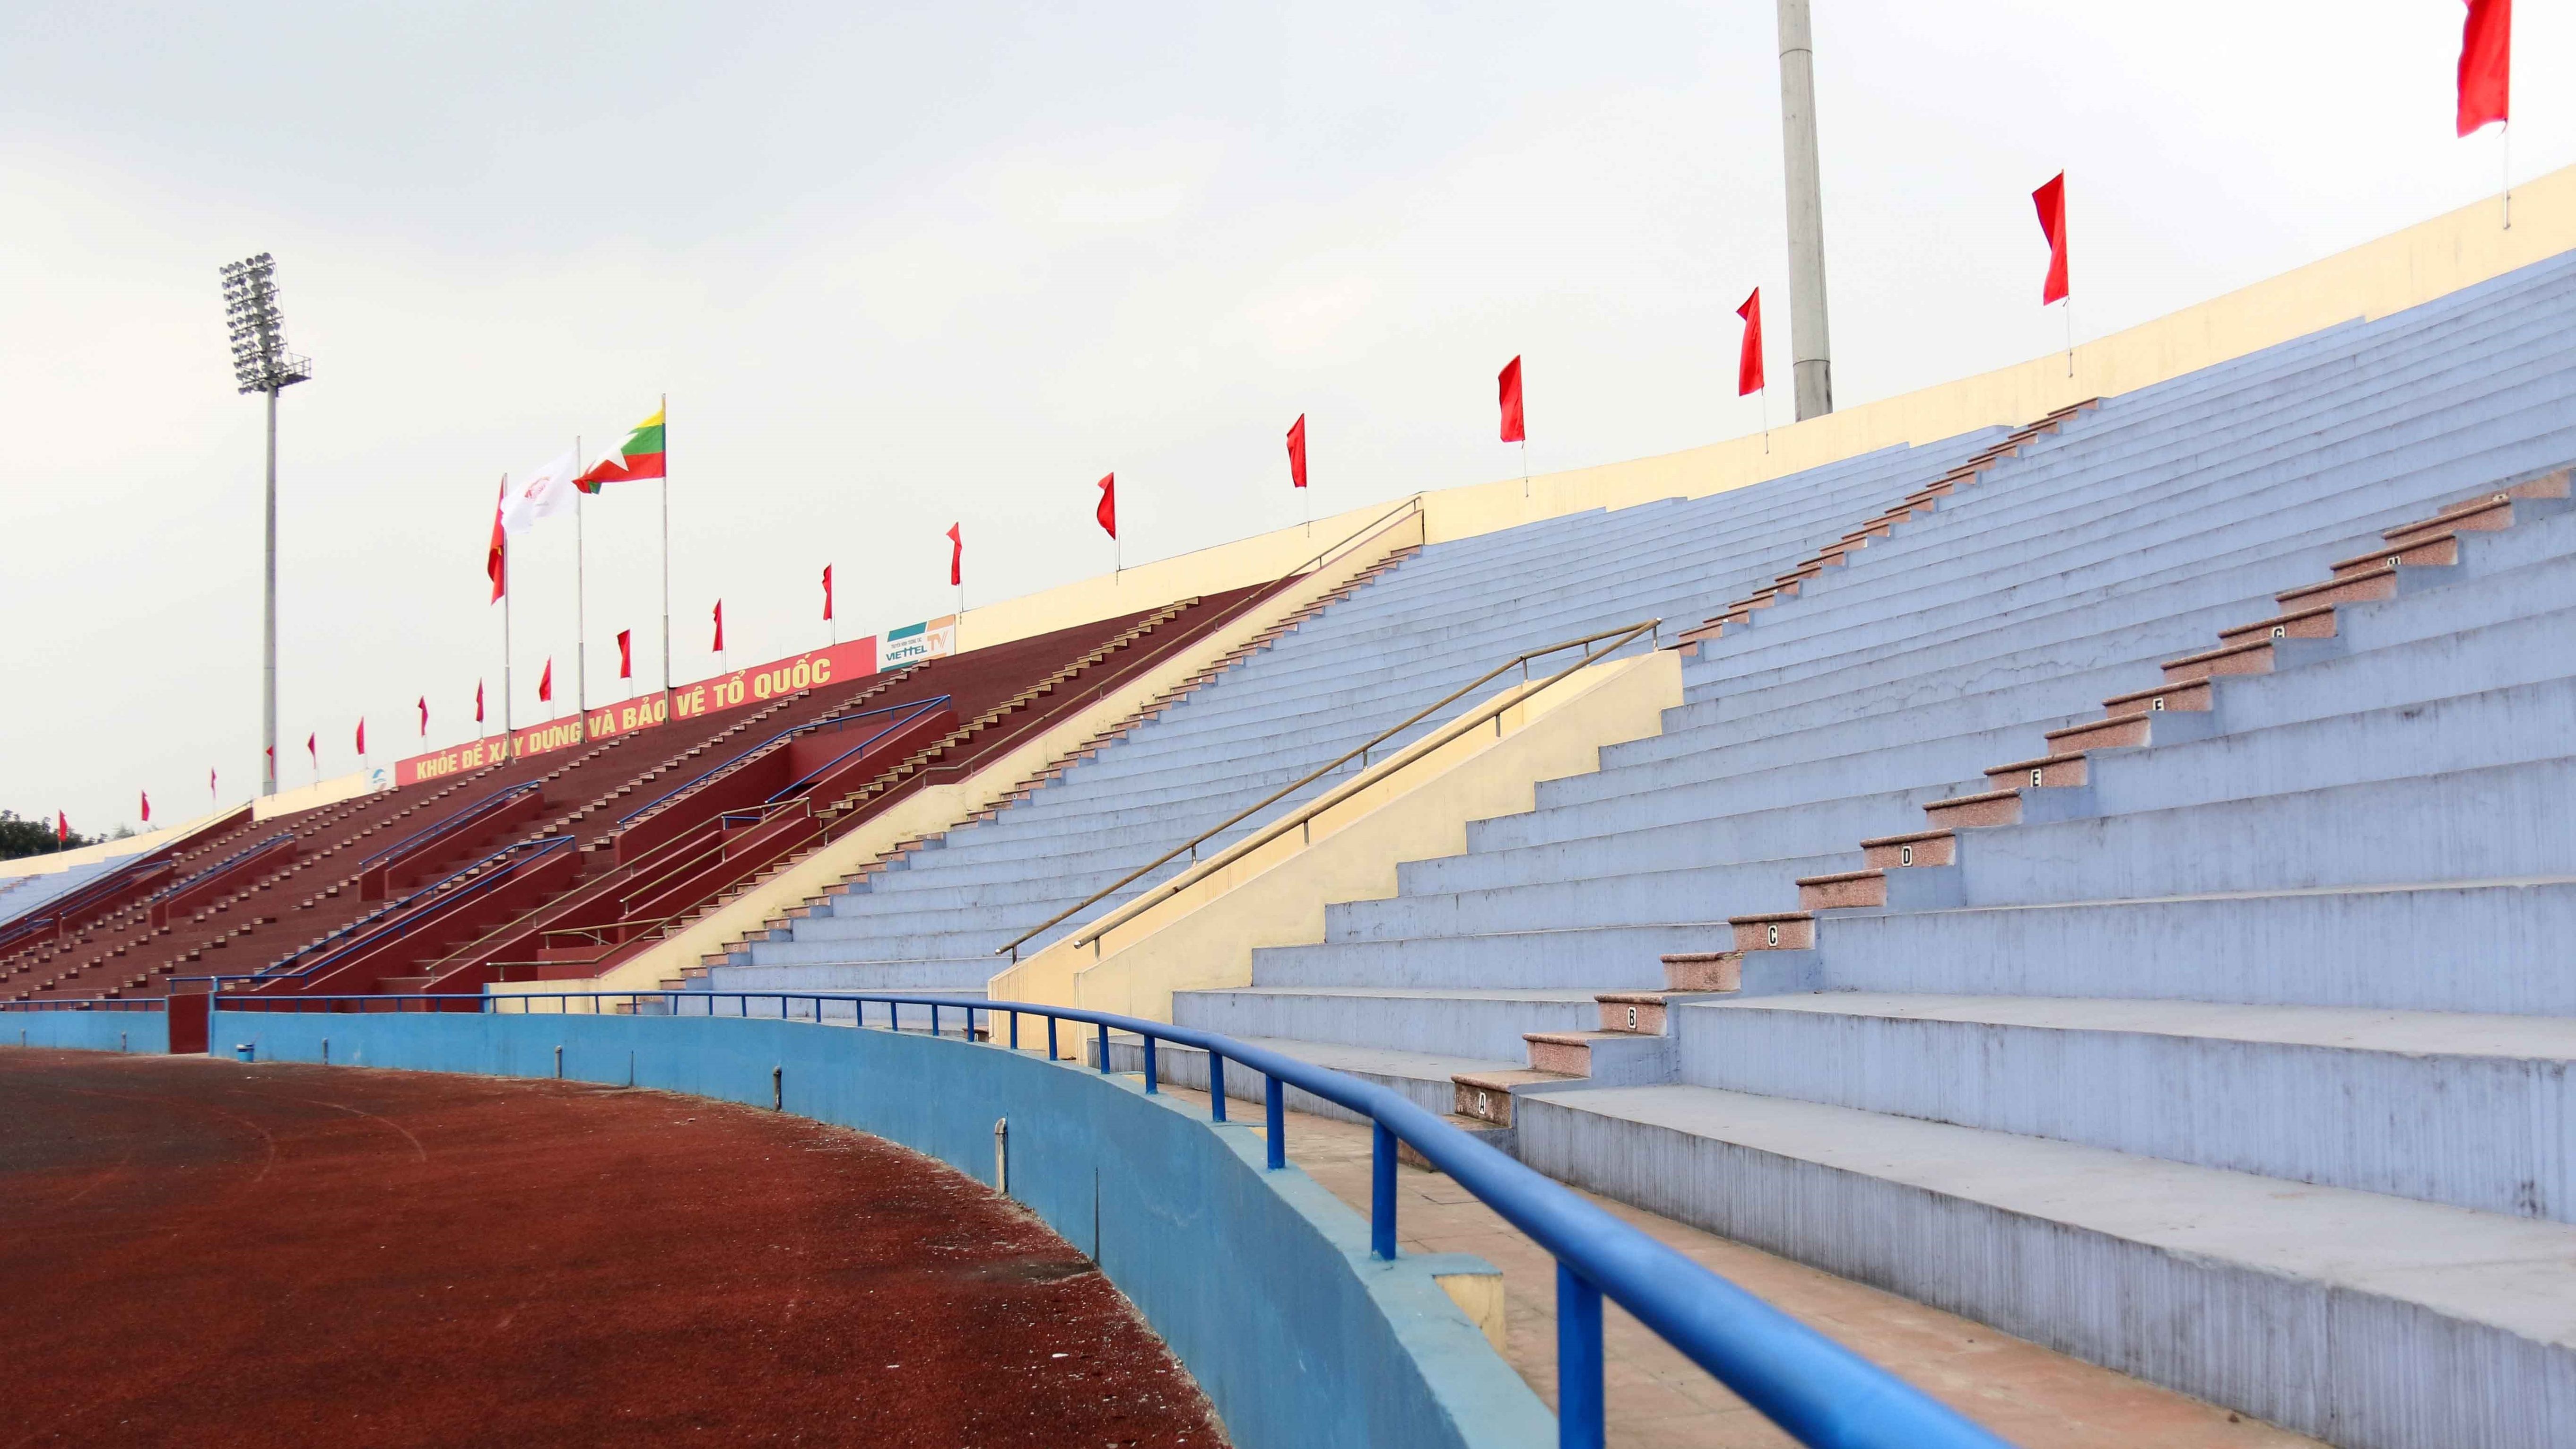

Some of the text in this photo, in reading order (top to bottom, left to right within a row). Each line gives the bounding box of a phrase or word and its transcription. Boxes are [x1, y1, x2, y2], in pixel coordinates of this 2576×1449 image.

[417, 751, 457, 780] KHỎE
[462, 739, 484, 768] ĐỂ
[530, 722, 583, 753] DỰNG
[589, 709, 616, 738] VÀ
[623, 697, 668, 730] BẢO
[677, 685, 705, 716] VỆ
[713, 670, 746, 707] TỔ
[754, 653, 831, 699] QUỐC
[2033, 771, 2039, 787] E
[1903, 848, 1910, 864] D
[1769, 927, 1776, 944] C
[1629, 1009, 1635, 1026] B
[1479, 1094, 1485, 1112] A
